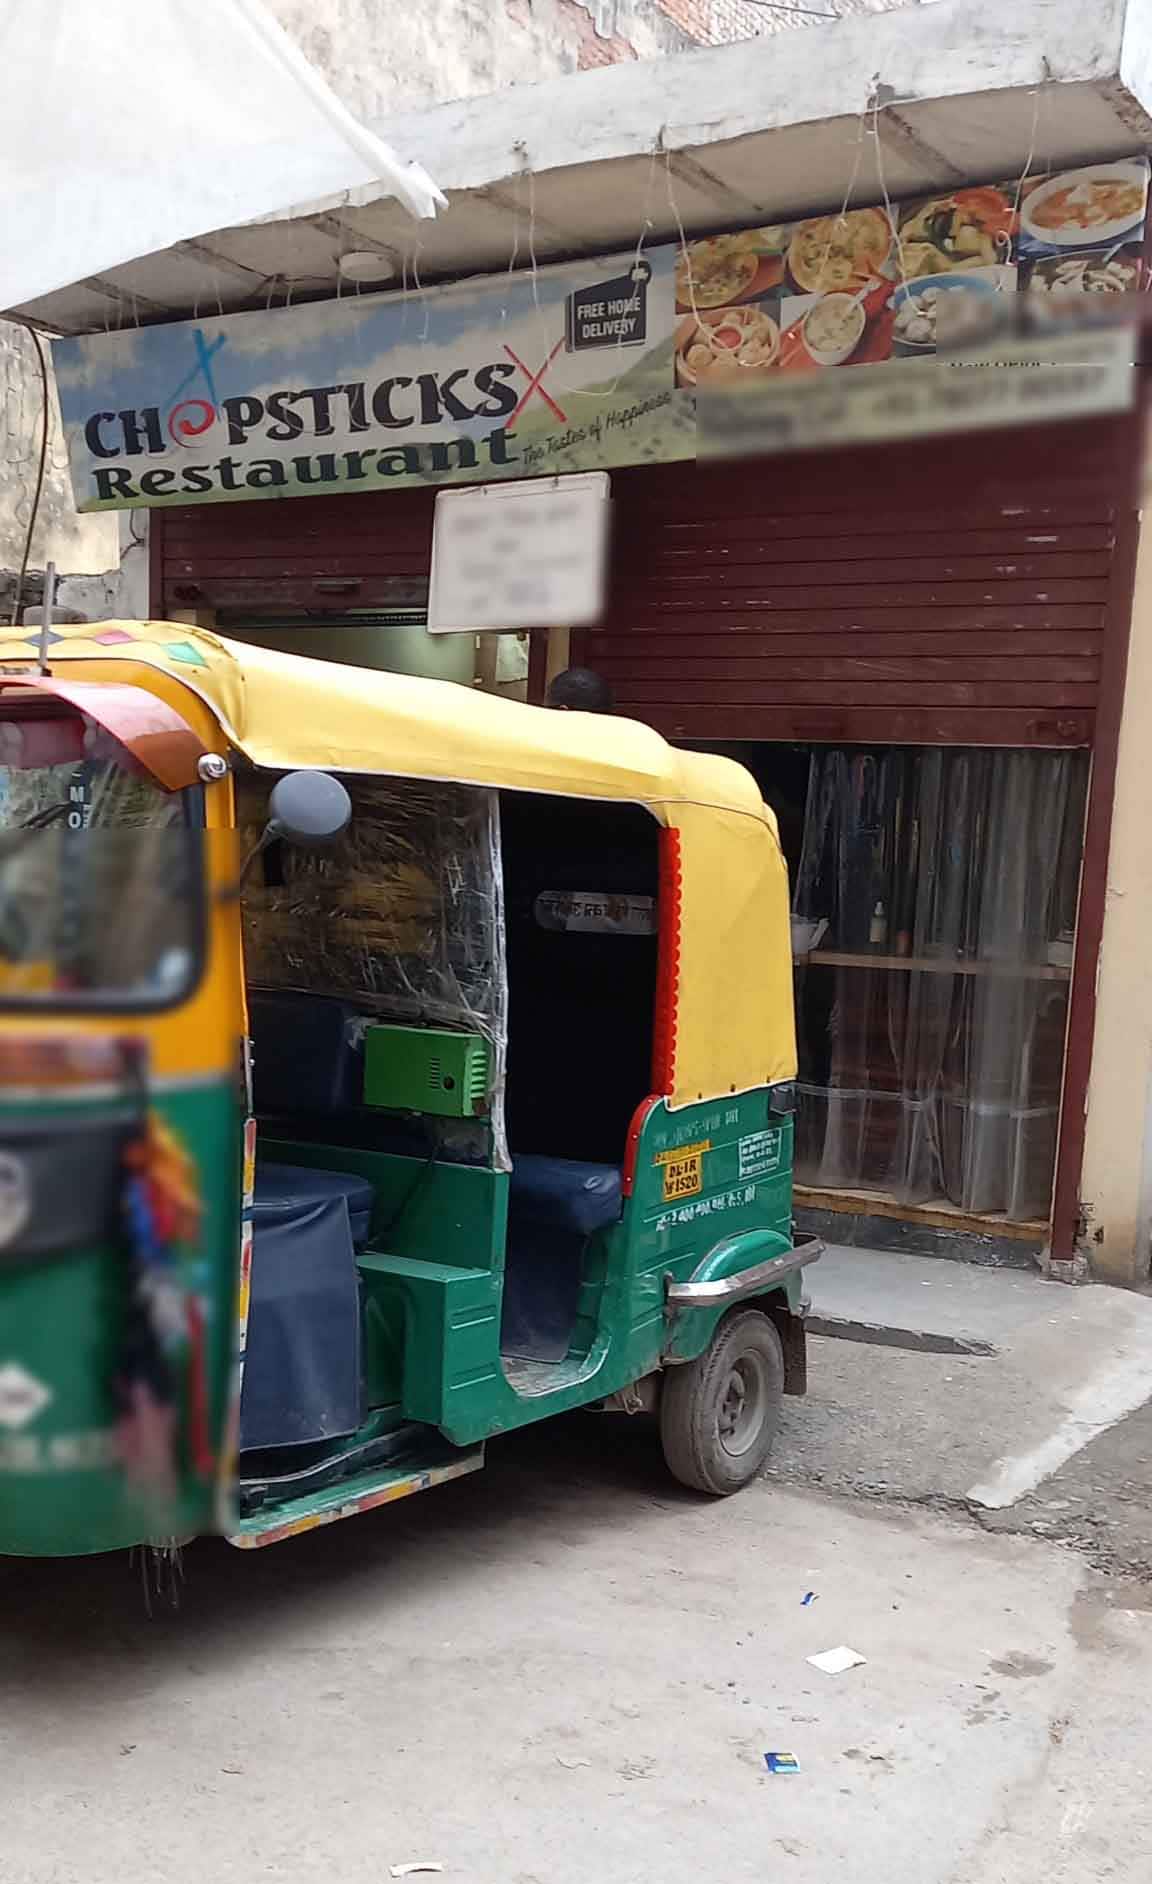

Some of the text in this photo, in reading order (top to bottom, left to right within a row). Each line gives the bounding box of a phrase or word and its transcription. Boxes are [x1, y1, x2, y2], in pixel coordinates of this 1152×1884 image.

[577, 297, 641, 321] FREE HOME
[582, 318, 637, 339] DELIVERY
[84, 363, 519, 459] CHOPSTICKS
[522, 445, 544, 465] The
[589, 415, 602, 441] of
[606, 391, 672, 428] Happiness
[92, 427, 520, 501] Restaurant
